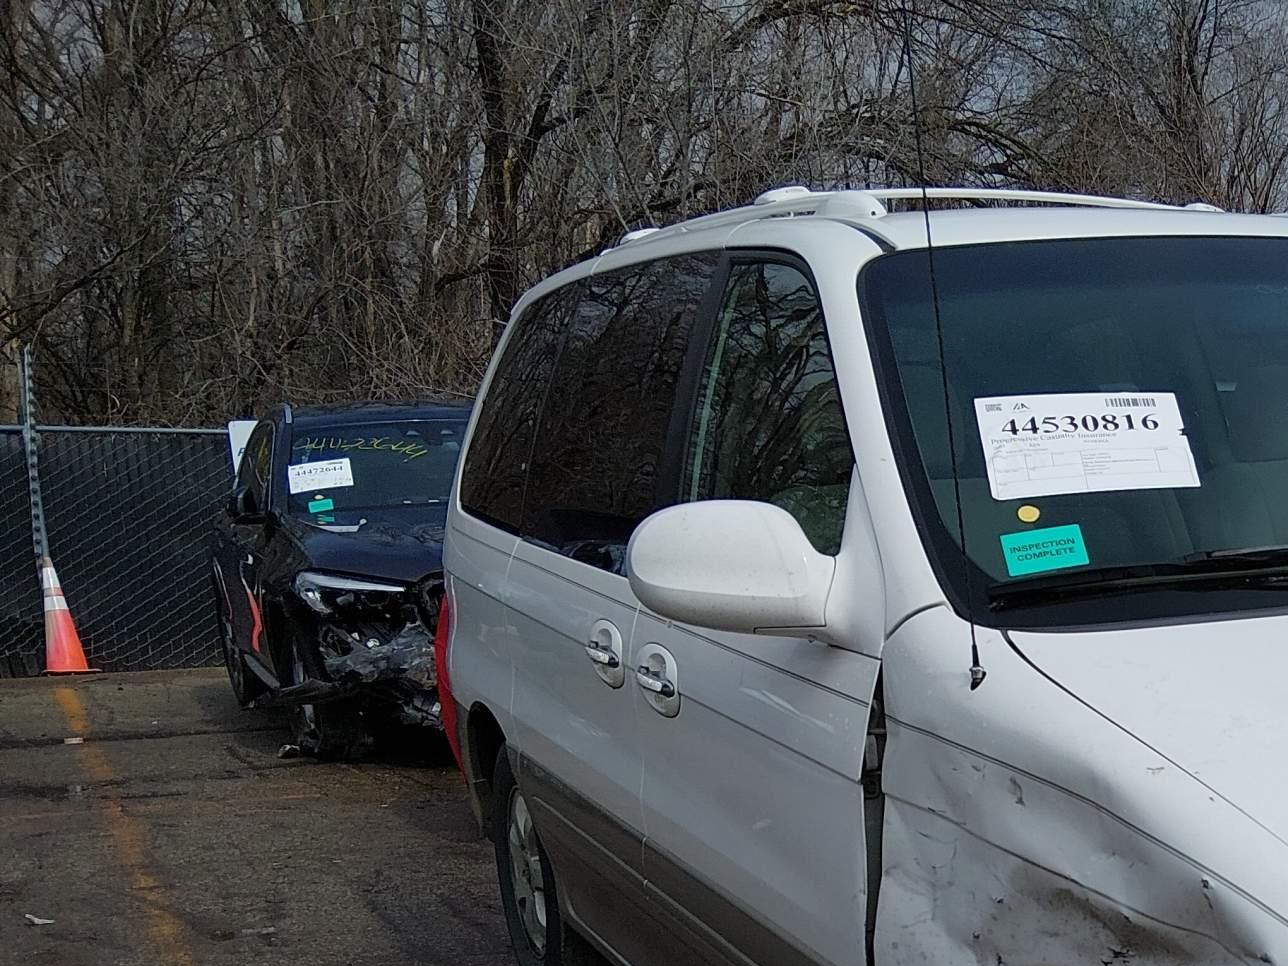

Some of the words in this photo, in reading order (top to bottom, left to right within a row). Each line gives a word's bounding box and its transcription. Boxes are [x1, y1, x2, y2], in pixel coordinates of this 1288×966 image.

[1001, 412, 1159, 436] 44530816
[1009, 537, 1076, 554] INSPECTION
[1017, 547, 1076, 562] COMPLETE
